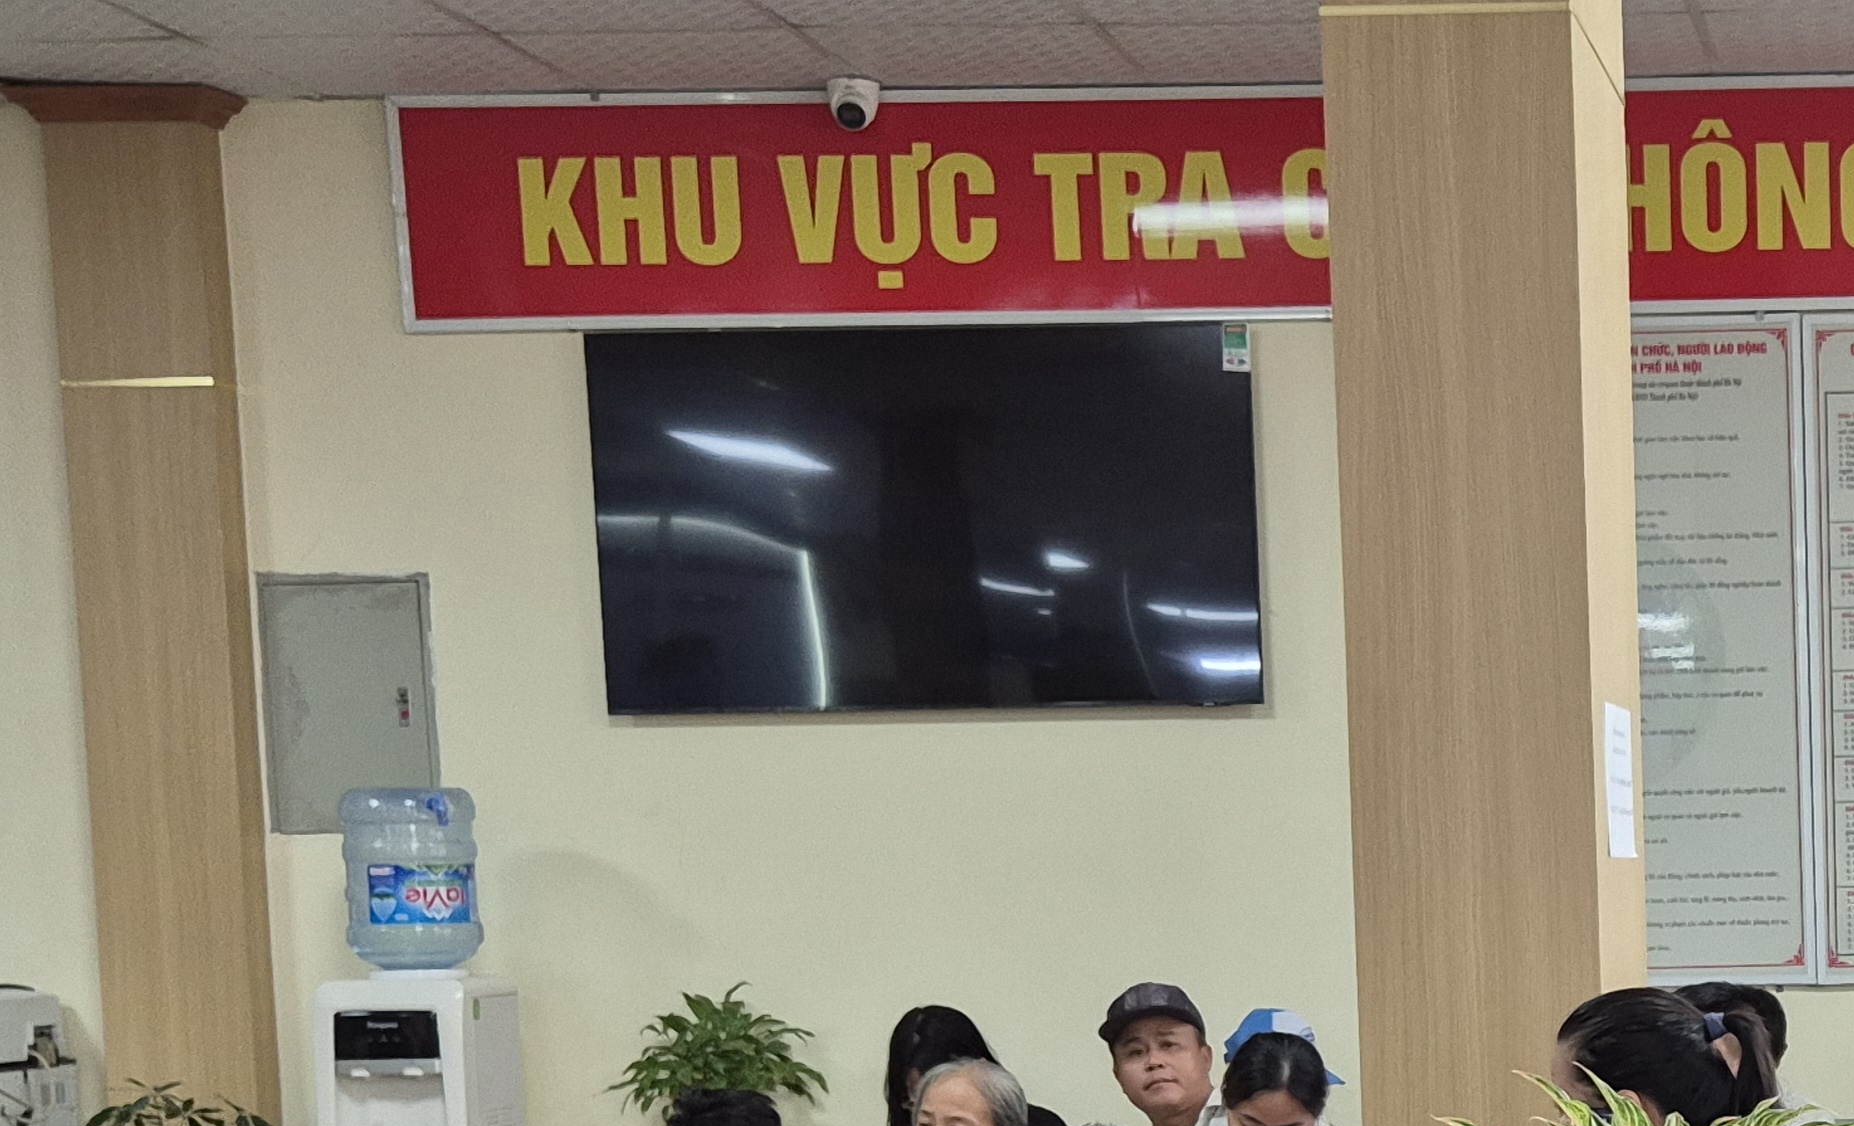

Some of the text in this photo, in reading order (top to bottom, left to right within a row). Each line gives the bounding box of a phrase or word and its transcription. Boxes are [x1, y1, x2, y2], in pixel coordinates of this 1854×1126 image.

[517, 155, 743, 266] KHU
[777, 142, 998, 289] VỰC
[1033, 151, 1246, 262] TRA
[1714, 343, 1734, 355] LAO
[1665, 360, 1680, 373] HÀ
[1683, 359, 1702, 375] NỘI
